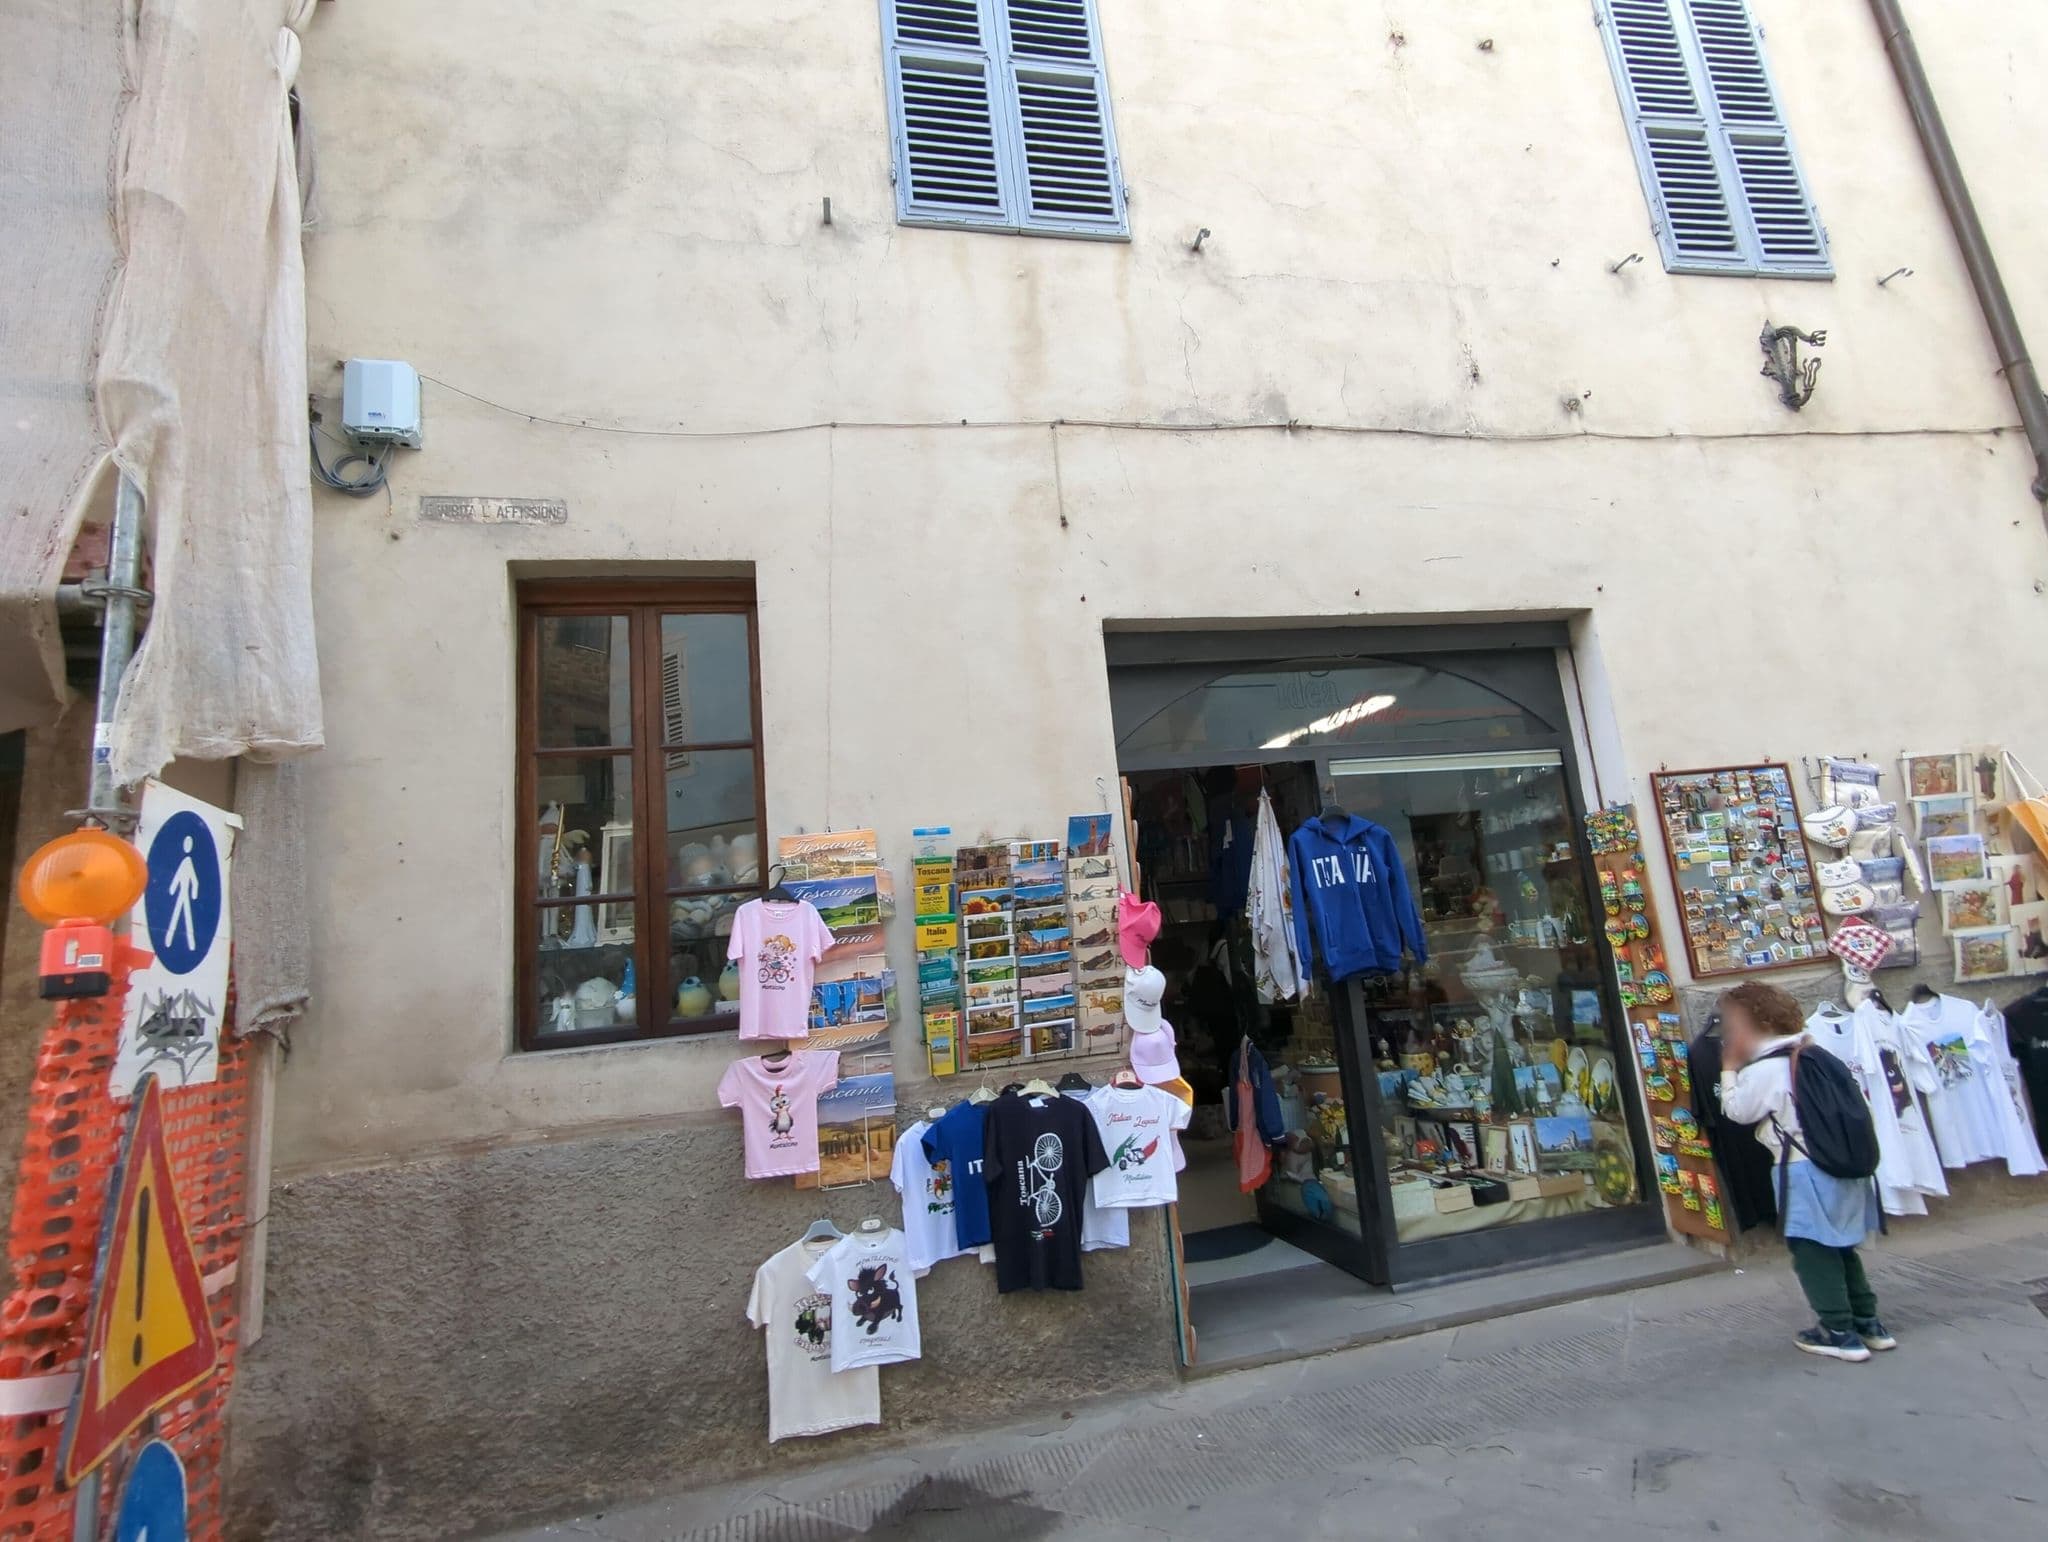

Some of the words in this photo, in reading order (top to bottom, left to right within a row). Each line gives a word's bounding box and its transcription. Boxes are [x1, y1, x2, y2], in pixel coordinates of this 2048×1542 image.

[497, 505, 563, 519] AFFISSIONE
[789, 838, 866, 857] Toscana
[916, 867, 951, 877] Toscana
[793, 884, 868, 900] Toscana
[926, 925, 948, 936] Italia
[1017, 1159, 1029, 1206] Toscana
